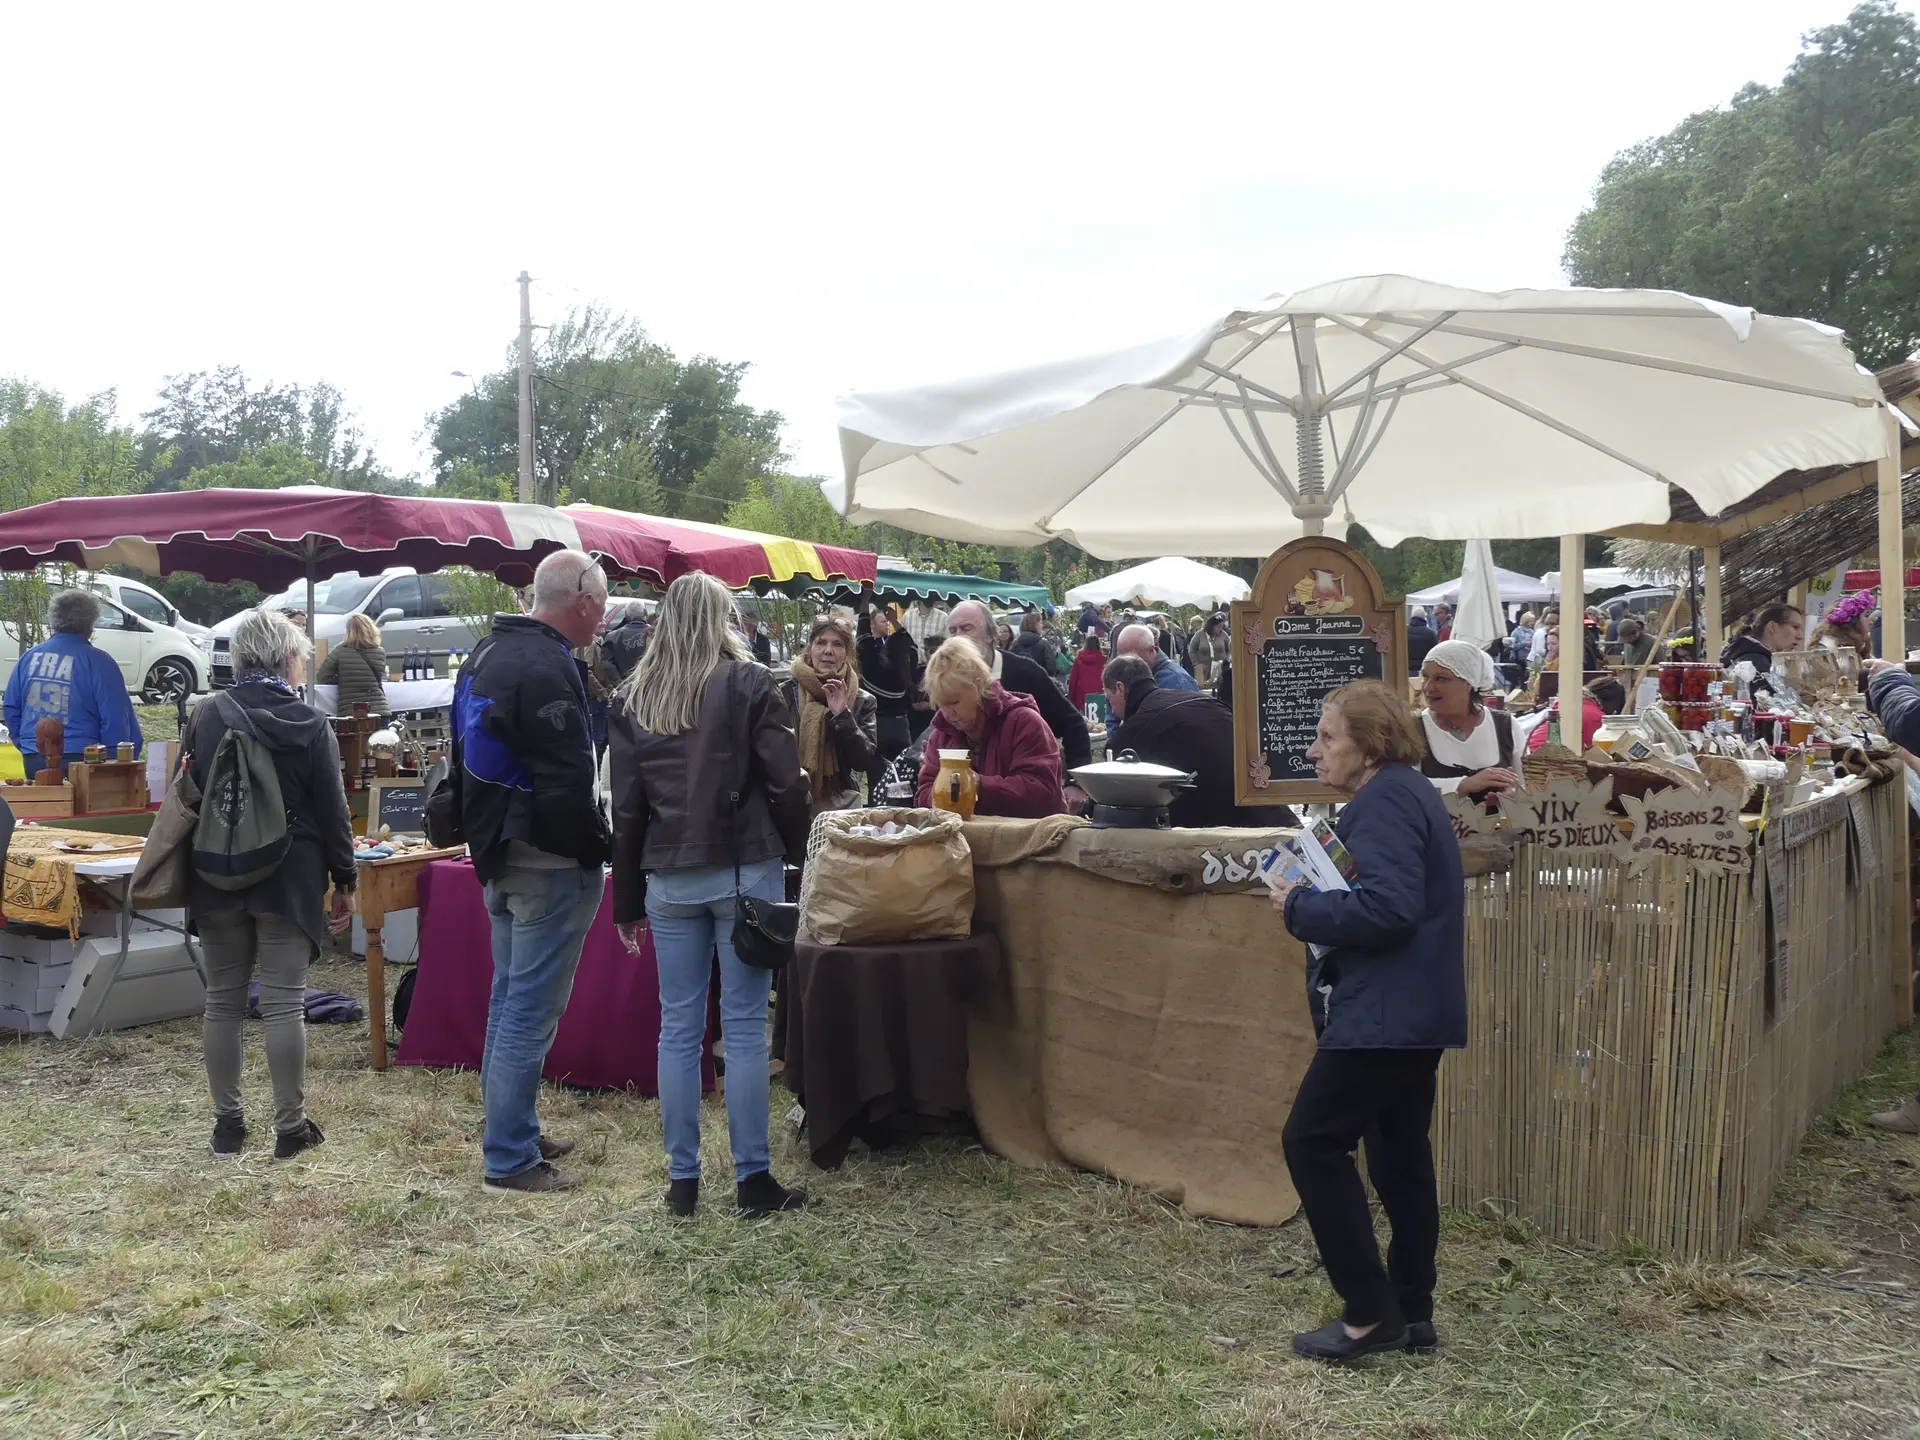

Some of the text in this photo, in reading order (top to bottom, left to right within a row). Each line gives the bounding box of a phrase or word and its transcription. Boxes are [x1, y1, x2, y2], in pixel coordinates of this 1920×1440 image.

[1277, 620, 1310, 634] Dame
[1268, 646, 1298, 657] Assiette
[28, 652, 74, 680] FRA
[1266, 668, 1296, 678] Tartine
[1310, 668, 1334, 678] Confit
[26, 681, 62, 714] 43
[1267, 698, 1284, 710] Café
[1297, 696, 1312, 705] thé
[1313, 699, 1322, 709] go
[1267, 722, 1282, 731] Vin
[1268, 733, 1282, 741] Thé
[1284, 733, 1302, 744] glacé
[1270, 742, 1285, 754] Café
[1288, 755, 1315, 772] Bon
[387, 790, 418, 798] Expo
